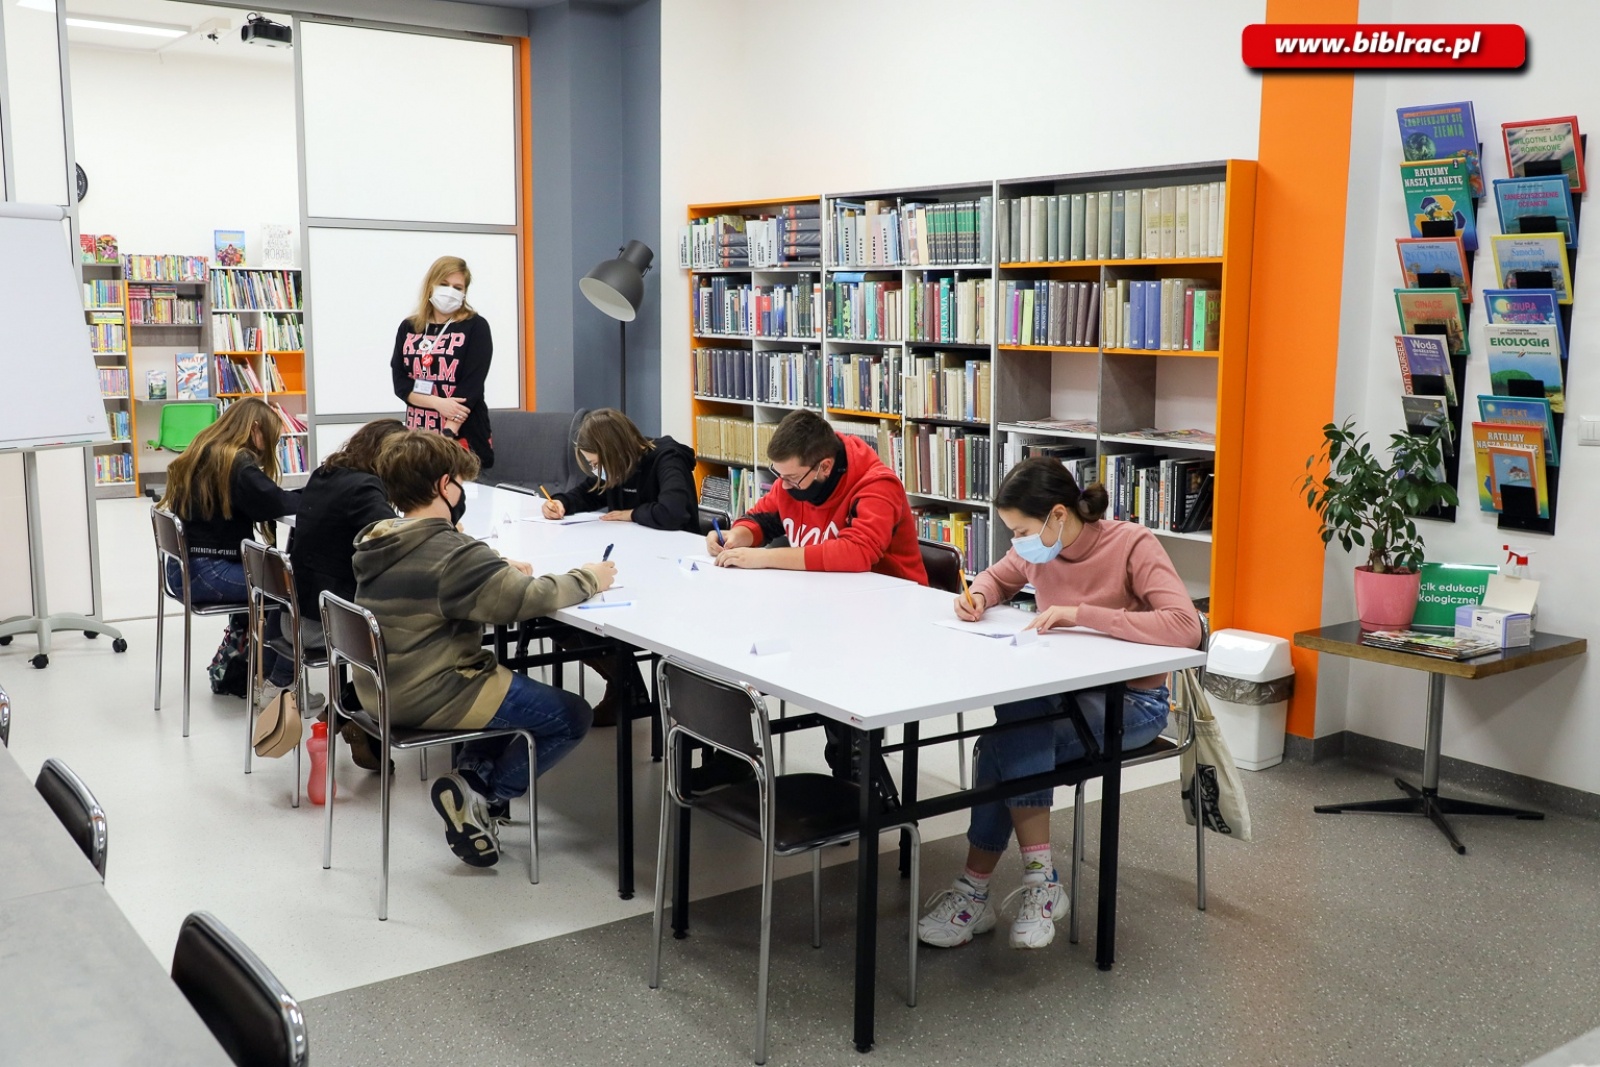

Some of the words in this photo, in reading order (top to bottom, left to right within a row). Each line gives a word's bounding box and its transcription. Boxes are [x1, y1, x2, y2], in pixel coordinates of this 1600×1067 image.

[1404, 115, 1450, 127] ZAOPIEKUJMY
[1451, 113, 1463, 123] SIĘ
[1433, 124, 1465, 138] ZIEMIĄ
[1549, 134, 1566, 142] LASY
[1520, 144, 1561, 153] RÓWNIKOWE
[1414, 167, 1449, 177] RATUJMY
[1404, 177, 1428, 187] NASZĄ
[1430, 175, 1463, 186] PLANETĘ
[1506, 302, 1537, 311] DZIURA
[941, 296, 949, 341] REKLAMA
[1410, 339, 1438, 350] Woda
[1490, 338, 1550, 347] EKOLOGIA
[1395, 338, 1410, 377] YOURSELF
[1403, 377, 1411, 385] IT
[1502, 408, 1528, 418] EFEKT
[1488, 432, 1524, 443] RATUJMY
[1419, 582, 1436, 591] cik
[1439, 583, 1485, 595] edukacji
[1419, 594, 1479, 605] kologicznej
